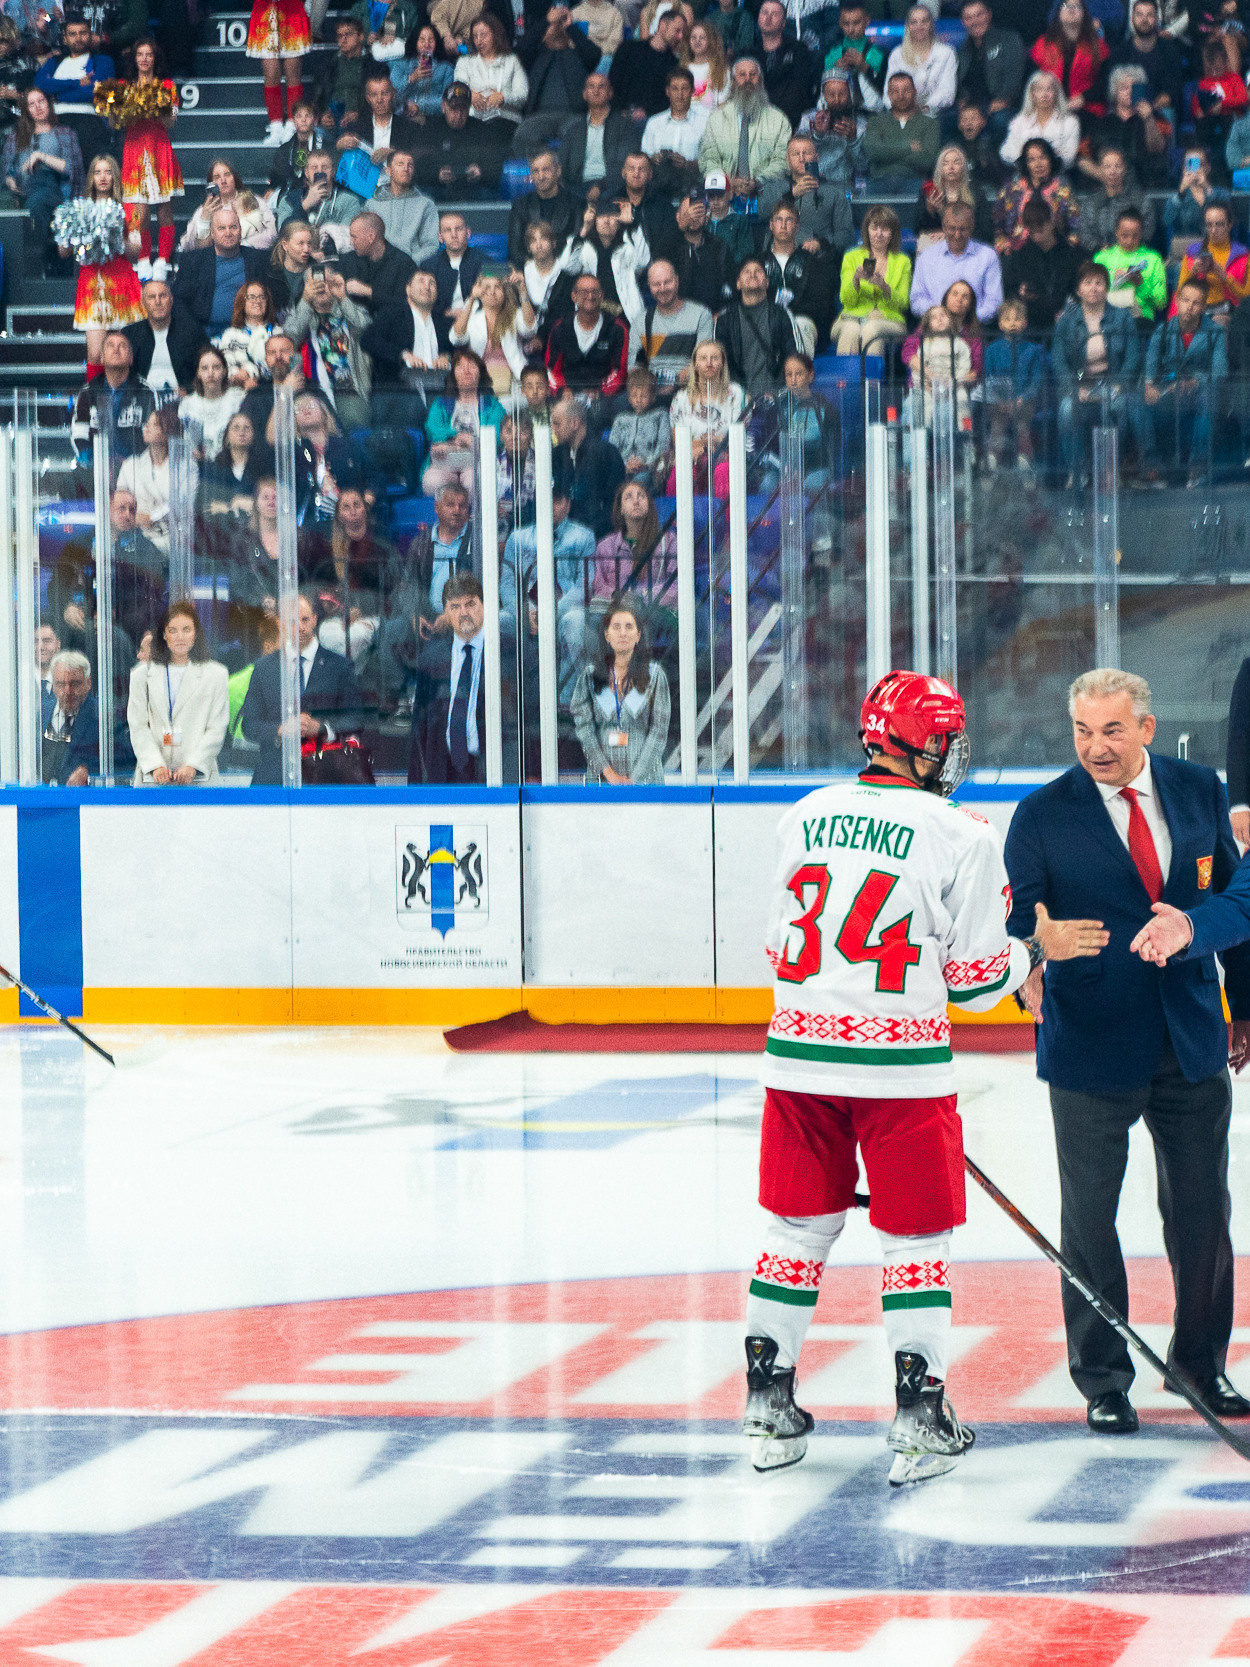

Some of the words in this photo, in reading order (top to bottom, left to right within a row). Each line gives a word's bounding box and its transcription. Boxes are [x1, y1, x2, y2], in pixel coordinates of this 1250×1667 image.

[215, 20, 248, 48] 10
[180, 85, 201, 109] 9
[866, 714, 886, 735] 34
[802, 814, 915, 861] YATSENKO
[777, 862, 922, 994] 34
